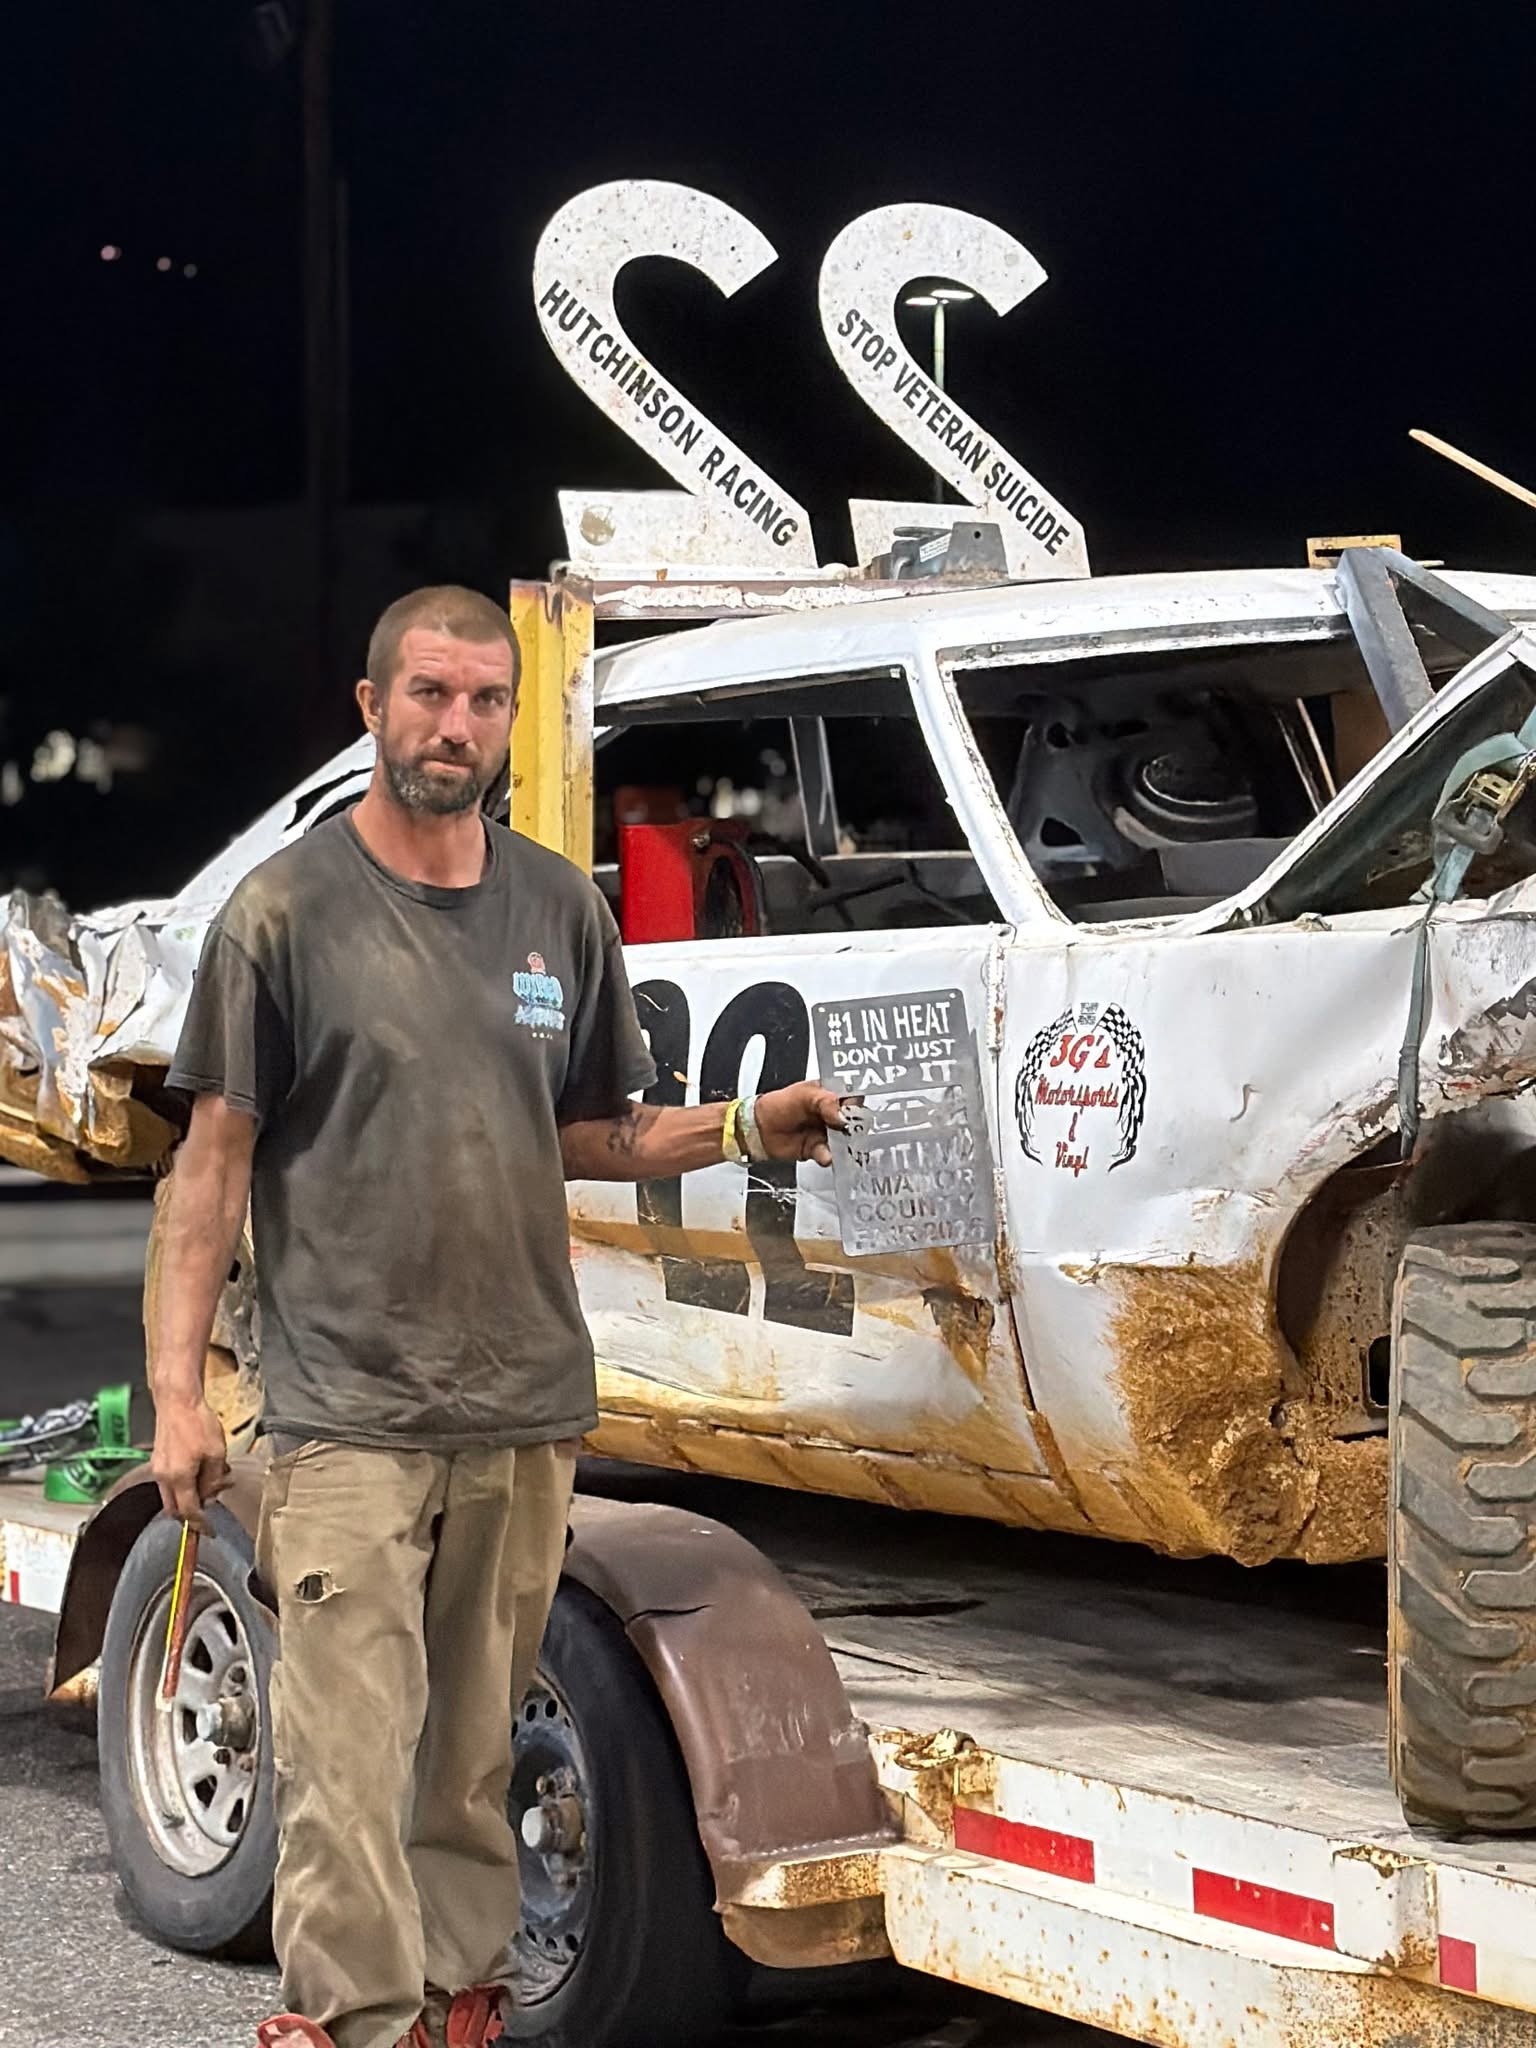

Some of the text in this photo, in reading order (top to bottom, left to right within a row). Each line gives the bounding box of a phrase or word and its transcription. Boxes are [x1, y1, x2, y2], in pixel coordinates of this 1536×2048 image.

[539, 279, 799, 547] HUTCHINSON RACING
[837, 308, 1071, 557] STOP VETERAN SUICIDE
[827, 1001, 951, 1046] #1 IN HEAT
[832, 1038, 956, 1068] DON'T JUST
[833, 1059, 958, 1091] TAP IT
[1055, 1141, 1089, 1178] Vinyl
[857, 1192, 976, 1222] COUNTY
